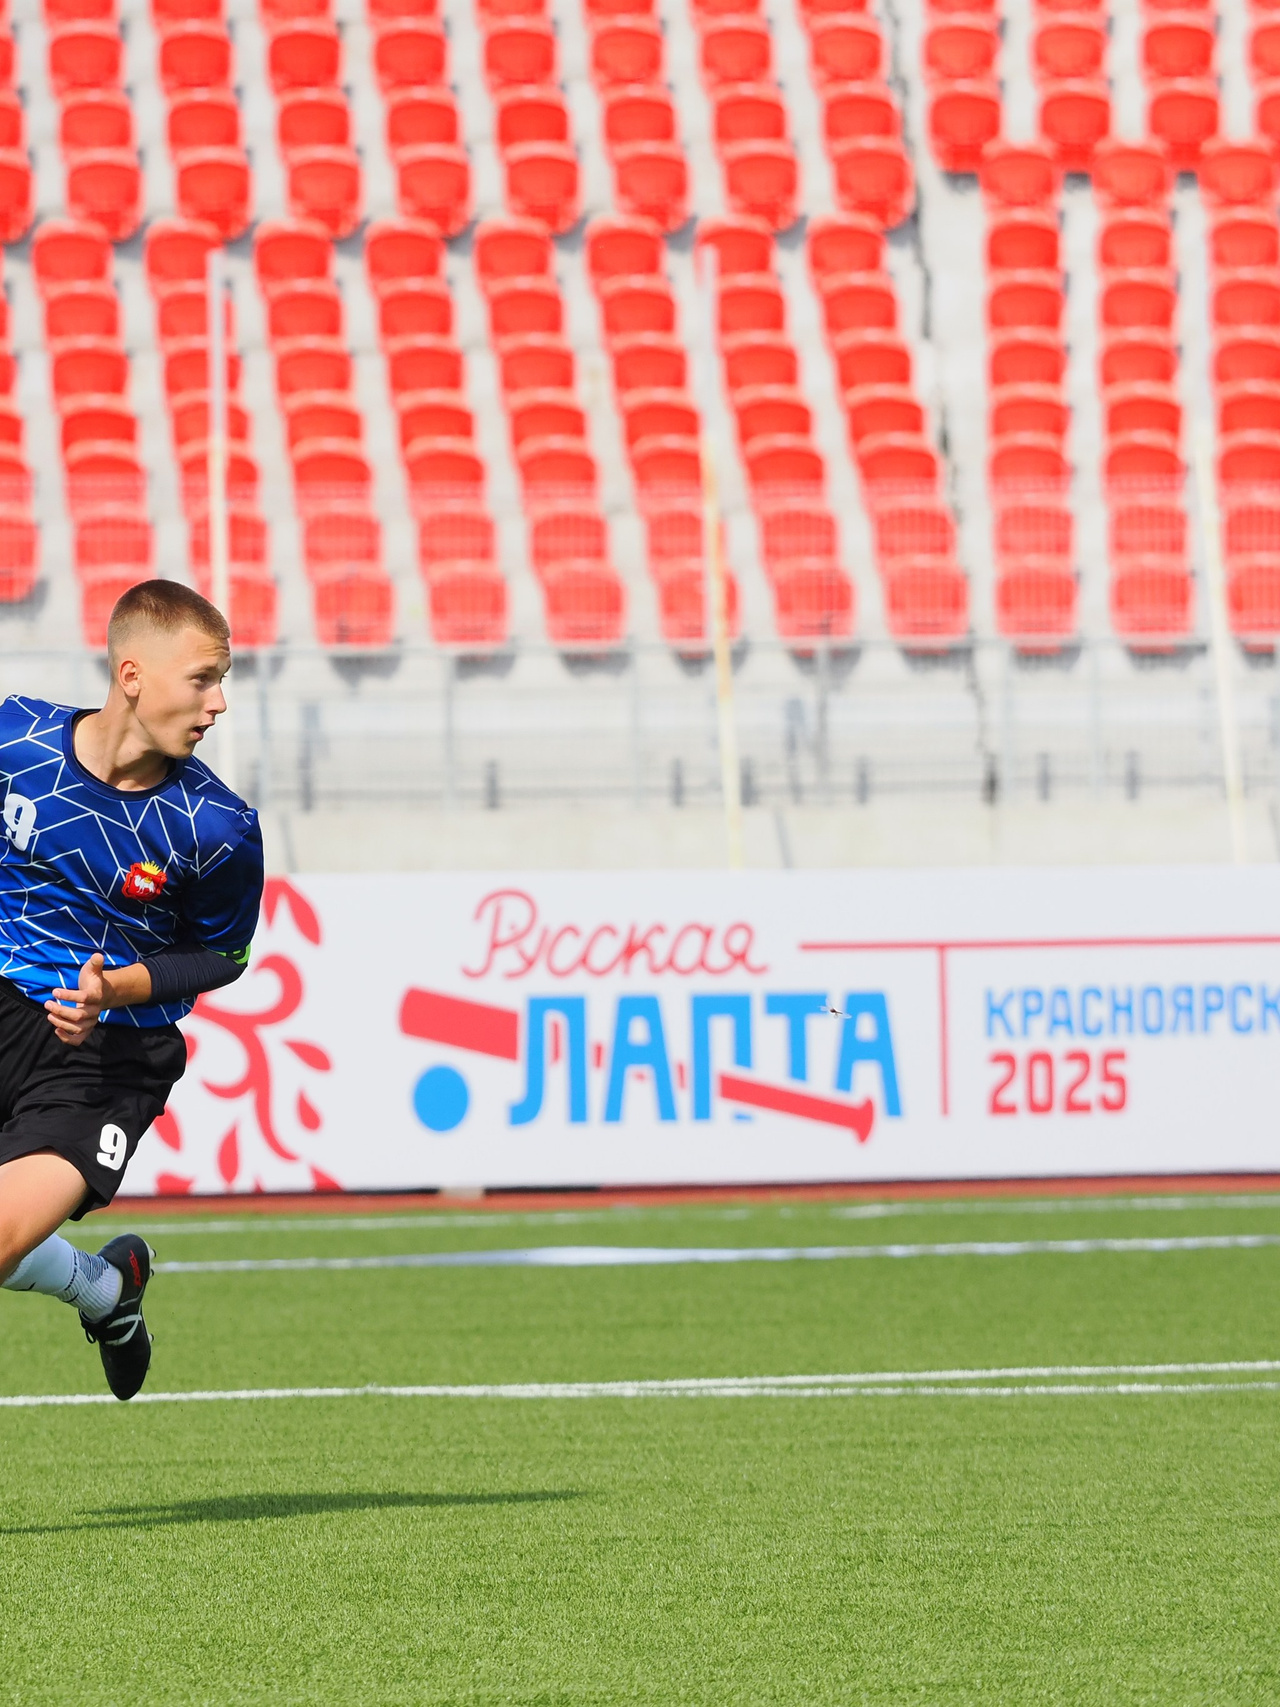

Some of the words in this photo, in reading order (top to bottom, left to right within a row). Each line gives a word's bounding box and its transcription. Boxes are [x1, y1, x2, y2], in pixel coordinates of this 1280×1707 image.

[3, 793, 37, 851] 9
[461, 887, 768, 979] Русская
[984, 982, 1280, 1040] КРАСНОЯРСК
[508, 990, 904, 1128] ЛАПТА
[987, 1049, 1129, 1117] 2025
[96, 1123, 127, 1171] 9
